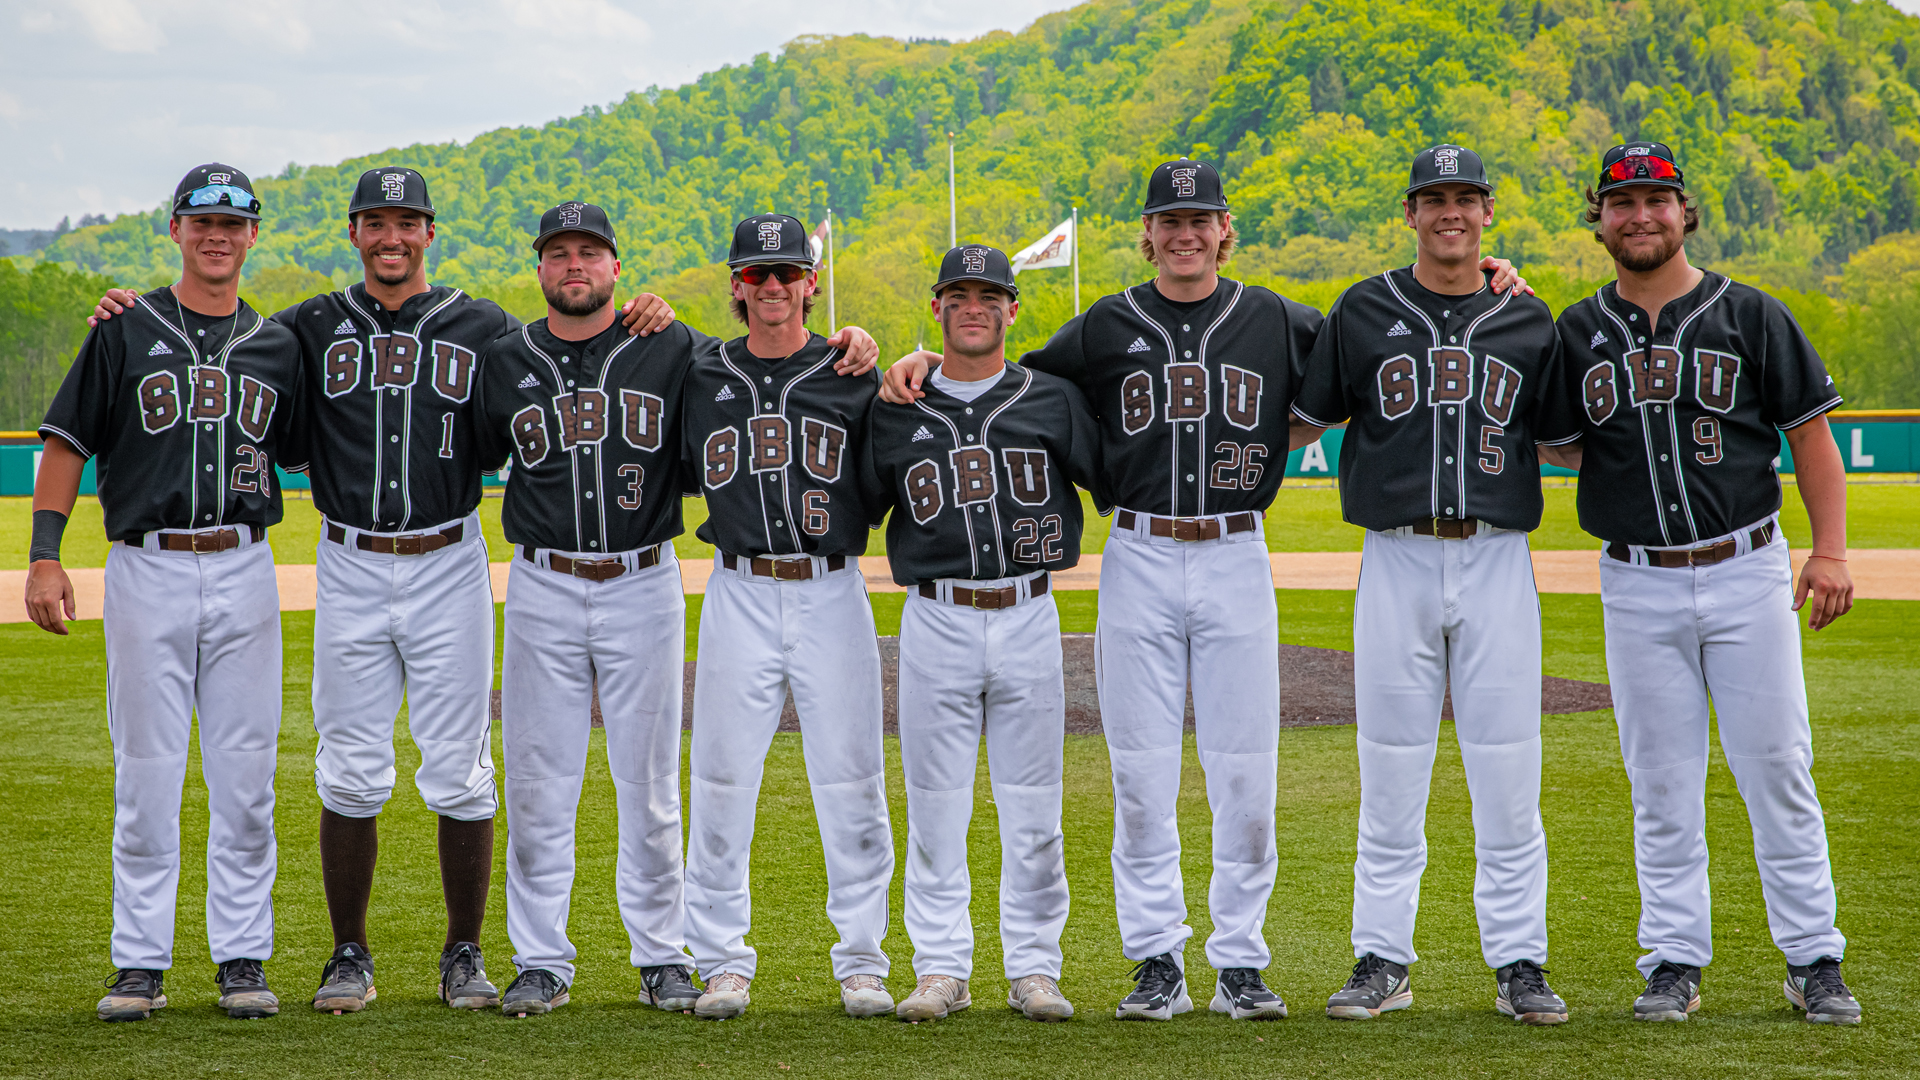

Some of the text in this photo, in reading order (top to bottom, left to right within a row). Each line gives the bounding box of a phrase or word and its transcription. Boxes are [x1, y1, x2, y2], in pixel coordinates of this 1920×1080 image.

[334, 327, 357, 335] adidas
[1127, 344, 1150, 353] adidas
[1387, 329, 1411, 337] adidas
[324, 330, 476, 404] SBU
[518, 380, 540, 389] adidas
[1377, 346, 1523, 427] SBU
[1582, 344, 1742, 426] SBU
[137, 365, 278, 443] SBU
[715, 392, 735, 401] adidas
[1120, 362, 1263, 436] SBU
[438, 411, 455, 459] 1
[510, 387, 664, 468] SBU
[704, 414, 847, 490] SBU
[911, 432, 934, 442] adidas
[1478, 424, 1504, 475] 5
[1692, 416, 1724, 465] 9
[230, 443, 271, 498] 28
[617, 463, 645, 511] 3
[904, 445, 1050, 526] SBU
[1210, 441, 1268, 491] 26
[801, 489, 830, 536] 6
[1012, 513, 1063, 564] 22
